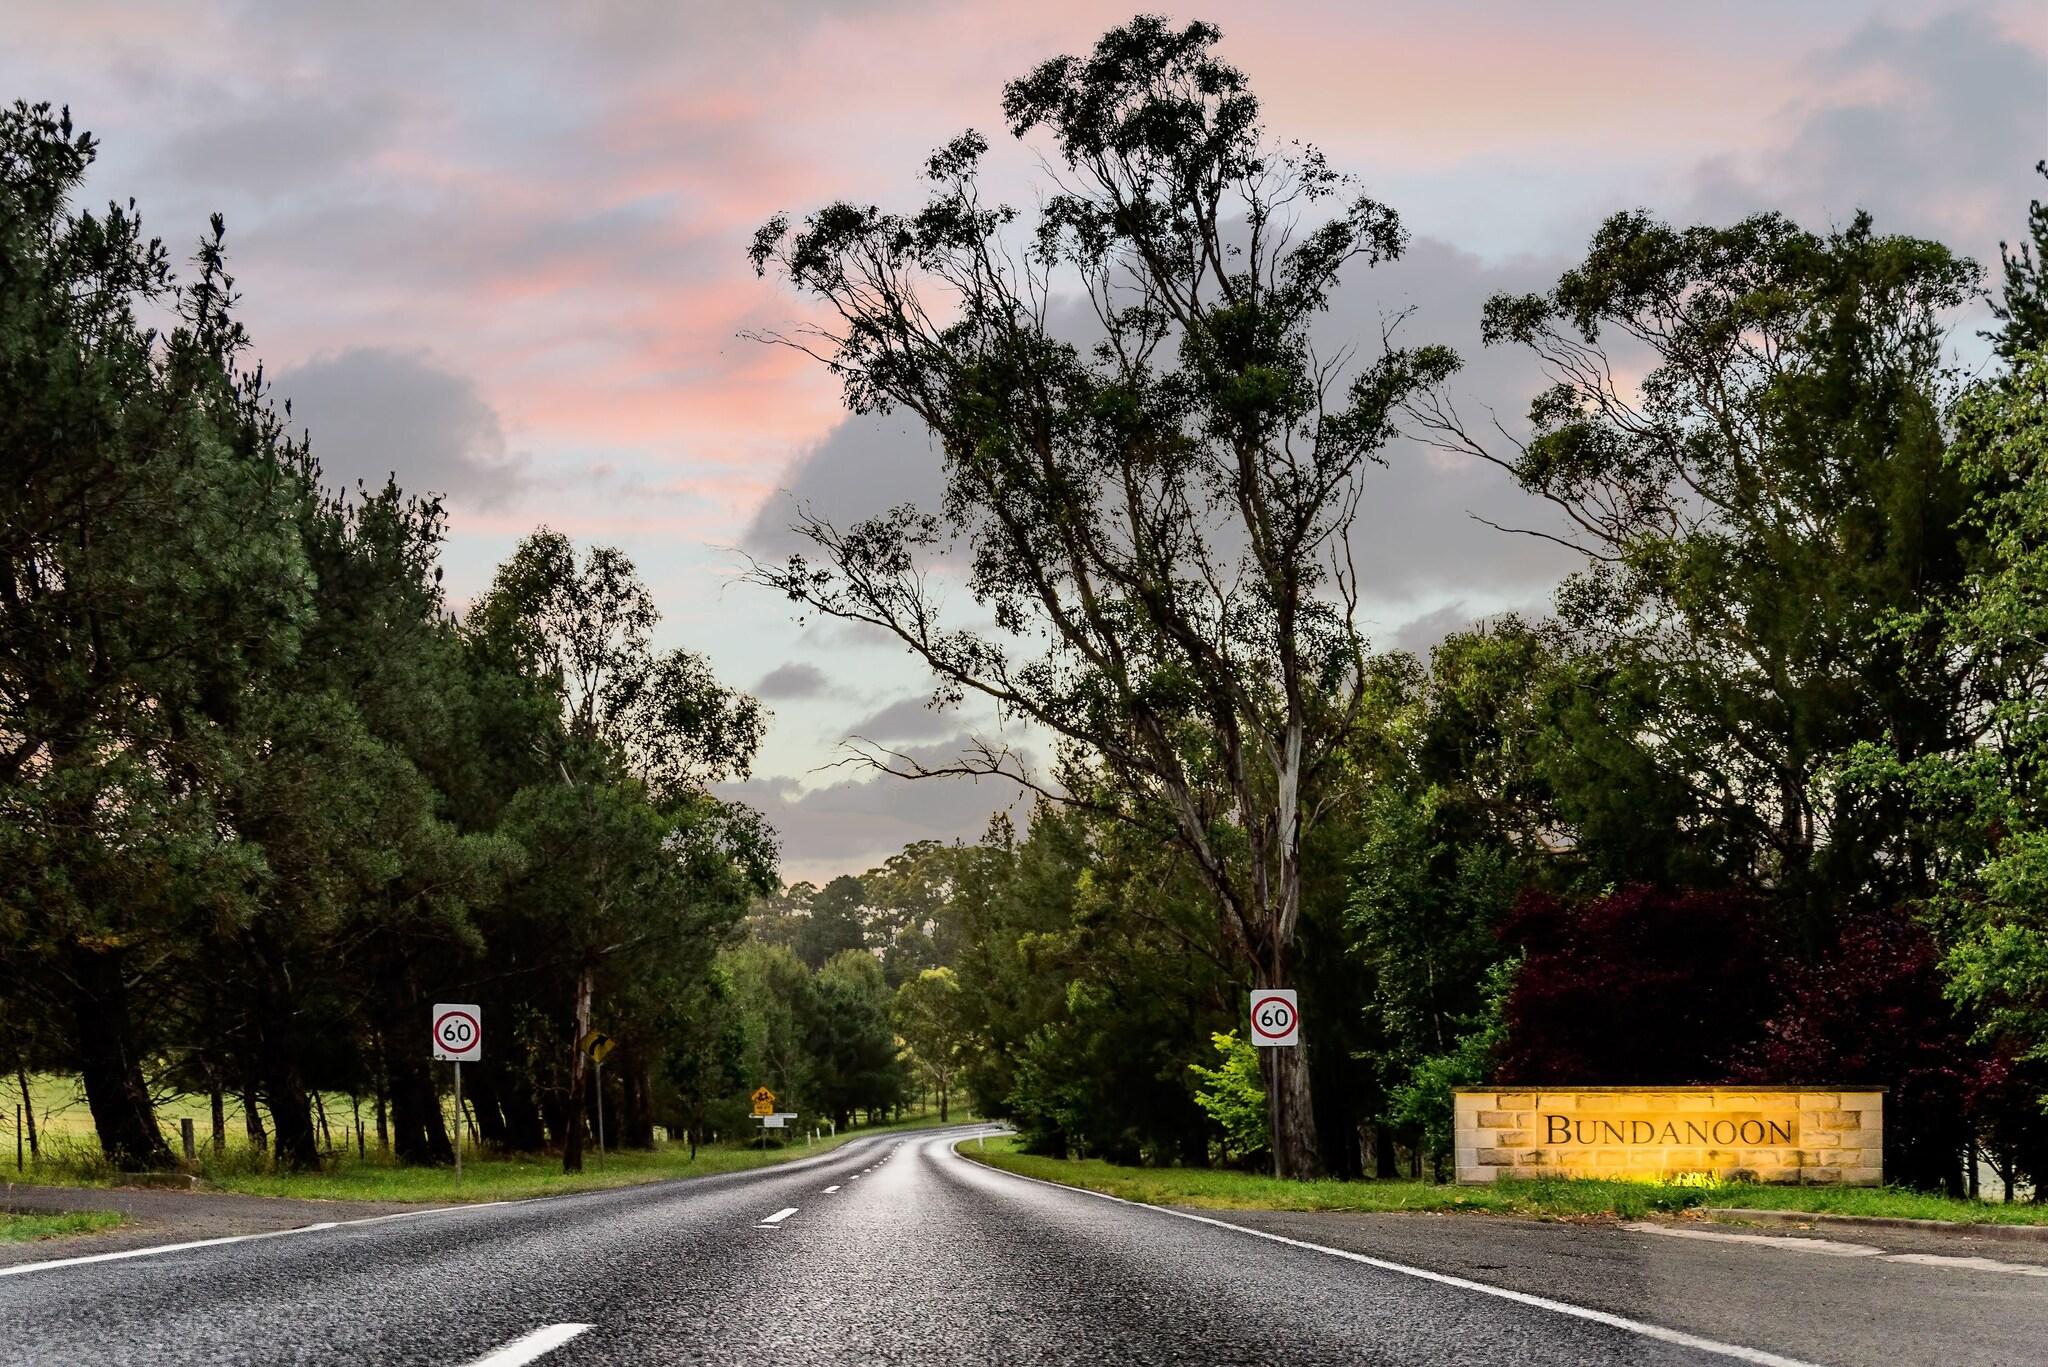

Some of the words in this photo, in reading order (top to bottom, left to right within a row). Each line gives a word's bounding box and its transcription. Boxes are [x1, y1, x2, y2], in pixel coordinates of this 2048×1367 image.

[1261, 1009, 1288, 1026] 60
[443, 1024, 471, 1041] 60
[1544, 1115, 1792, 1145] BUNDANOON
